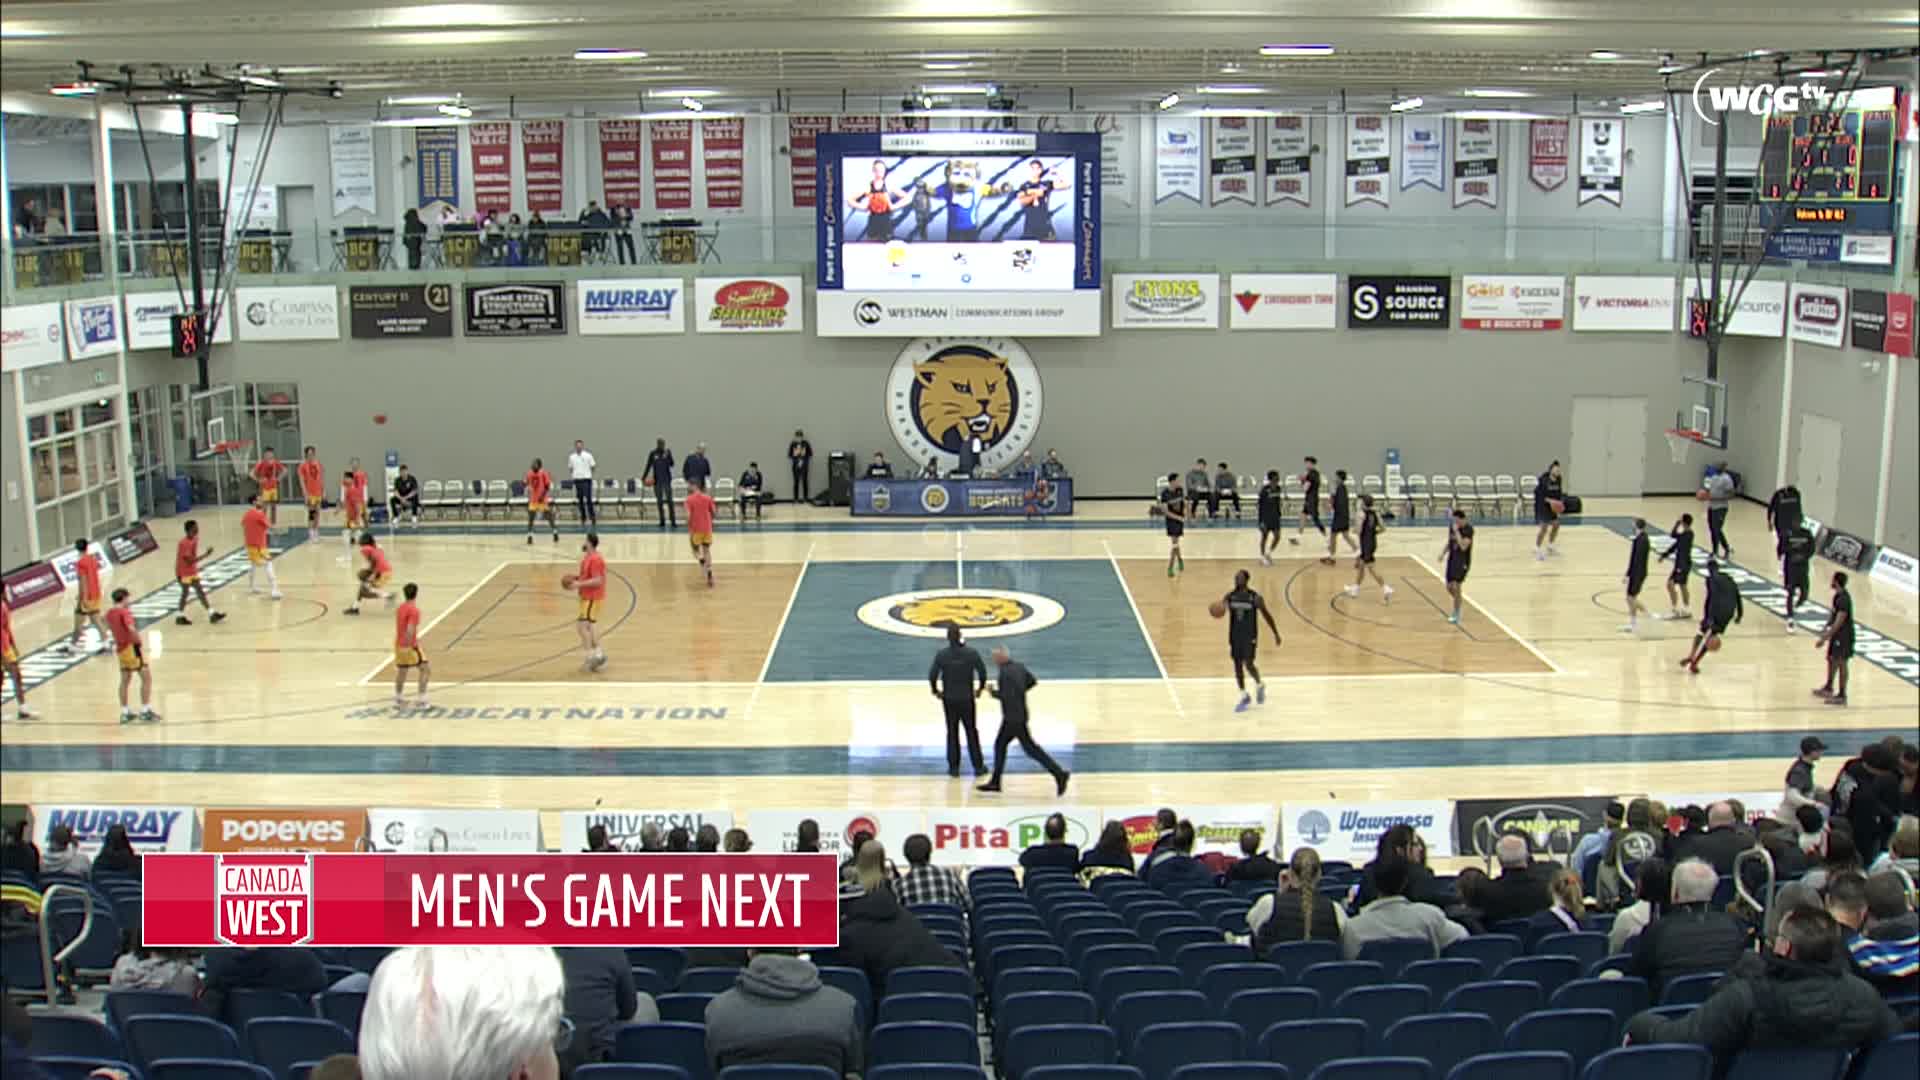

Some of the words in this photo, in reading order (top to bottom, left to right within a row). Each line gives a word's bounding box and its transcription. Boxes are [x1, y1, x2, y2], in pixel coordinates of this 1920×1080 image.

[1536, 139, 1564, 154] WEST
[431, 287, 449, 305] 21
[1135, 280, 1199, 297] LYONS
[1395, 286, 1437, 294] BRANDON
[353, 292, 397, 302] CENTURY
[586, 289, 678, 306] MURRAY
[1385, 296, 1445, 309] SOURCE
[1596, 298, 1649, 308] VICTORIA
[888, 308, 947, 318] WESTMAN
[1390, 312, 1406, 320] FOR
[1409, 312, 1439, 320] SPORTS
[47, 809, 182, 834] MURRAY
[1339, 810, 1433, 831] Wawanesa
[934, 824, 1009, 849] Pita
